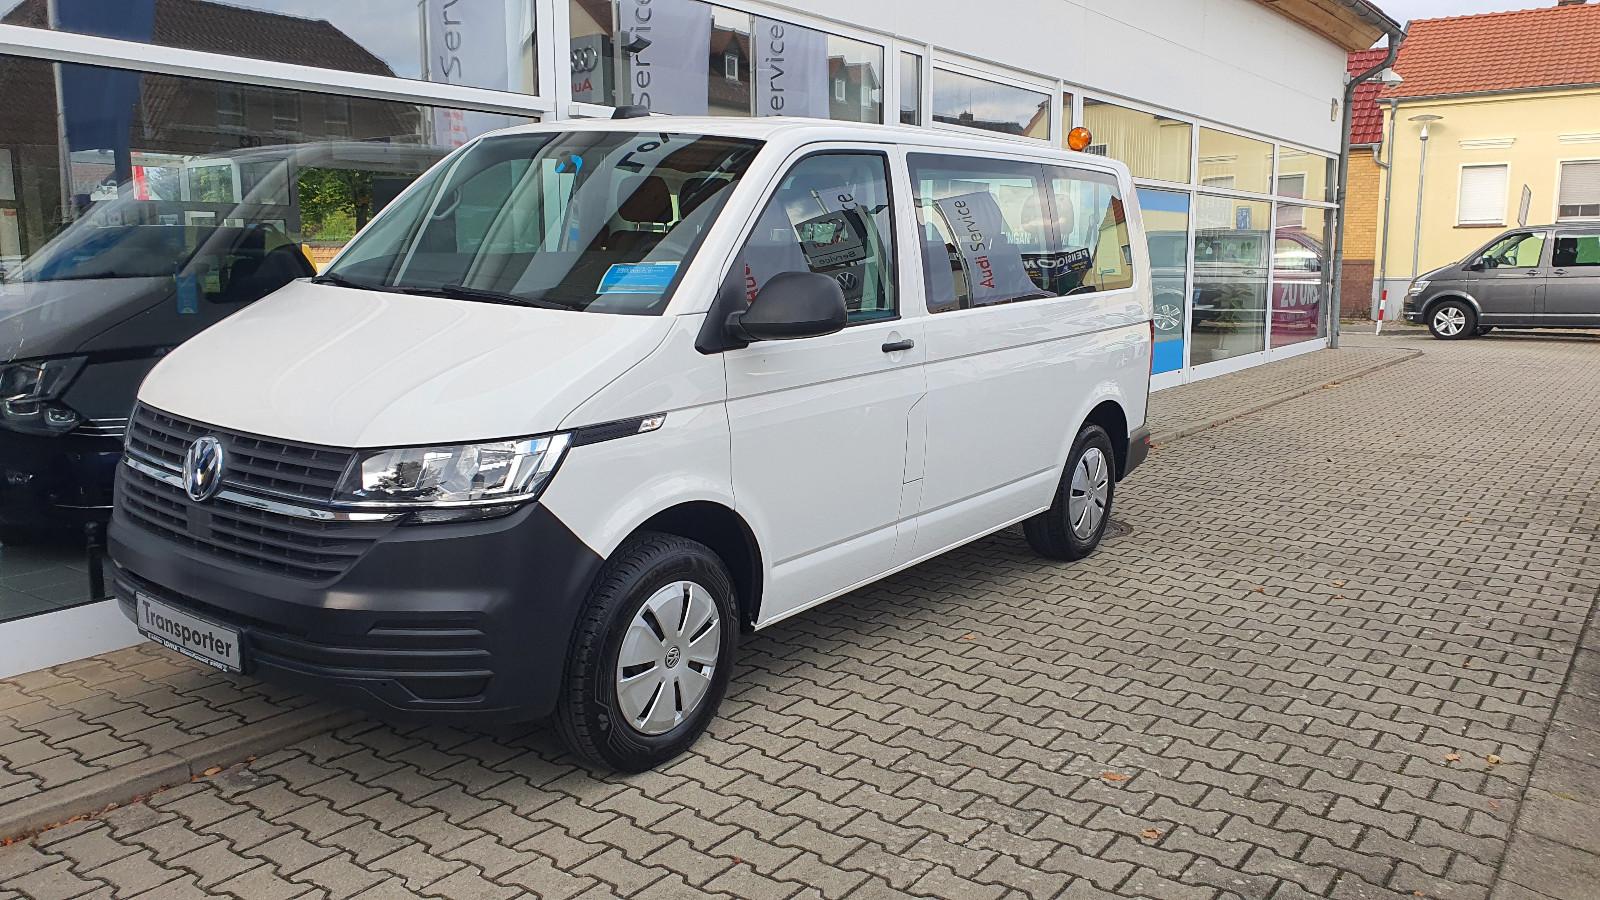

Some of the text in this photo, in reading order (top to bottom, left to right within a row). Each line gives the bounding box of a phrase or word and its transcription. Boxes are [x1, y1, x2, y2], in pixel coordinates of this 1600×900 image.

[765, 24, 785, 116] ervice
[954, 200, 995, 289] Audi Service
[1280, 283, 1298, 308] ZU
[142, 601, 232, 658] Transporter
